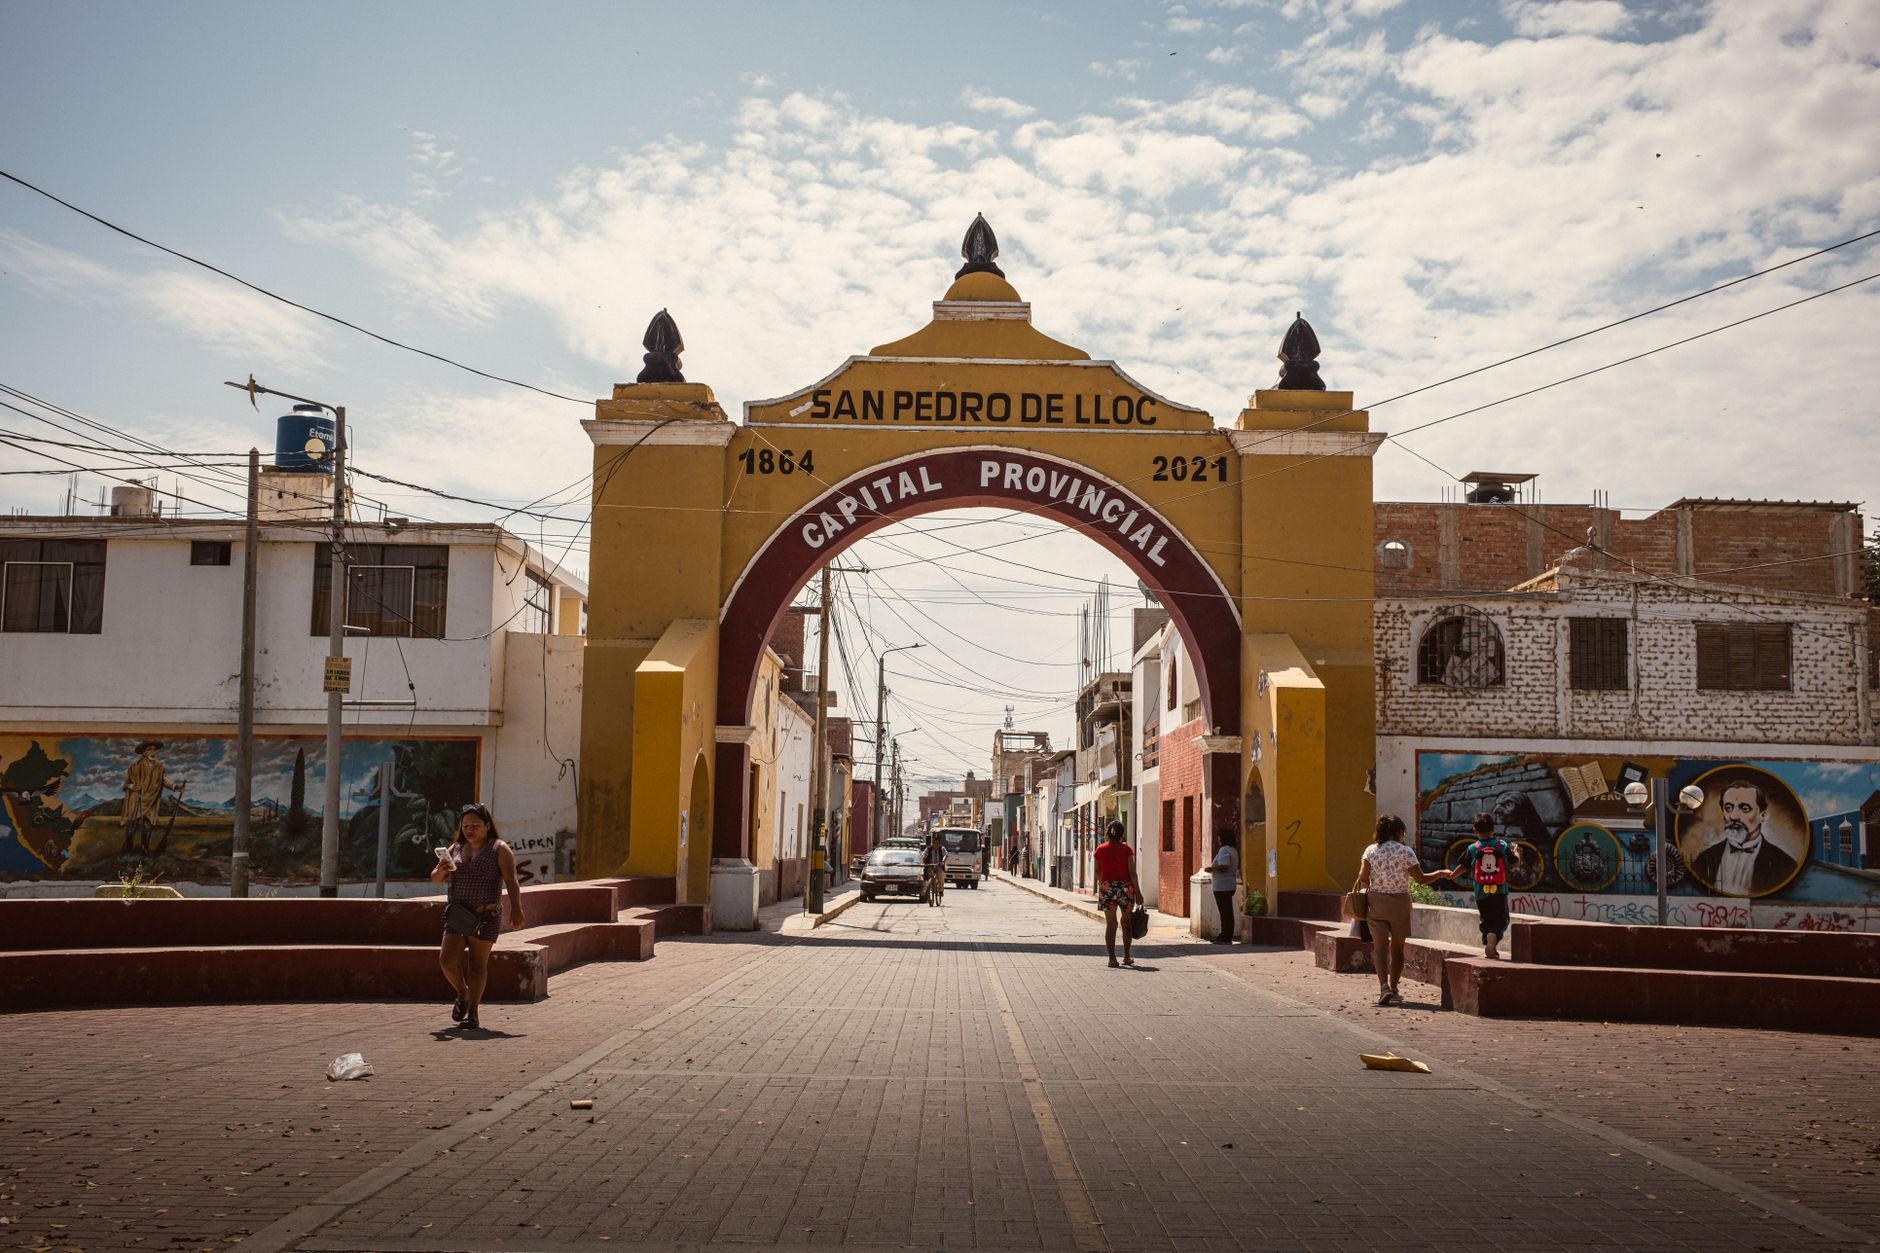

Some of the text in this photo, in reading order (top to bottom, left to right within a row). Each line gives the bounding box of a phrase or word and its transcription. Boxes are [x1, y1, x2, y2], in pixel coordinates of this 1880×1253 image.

[811, 389, 1157, 426] SAN PEDRO DE LLOC
[738, 448, 814, 475] 1864
[1152, 455, 1228, 482] 2021
[802, 461, 1169, 567] CAPITAL PROVINCIAL
